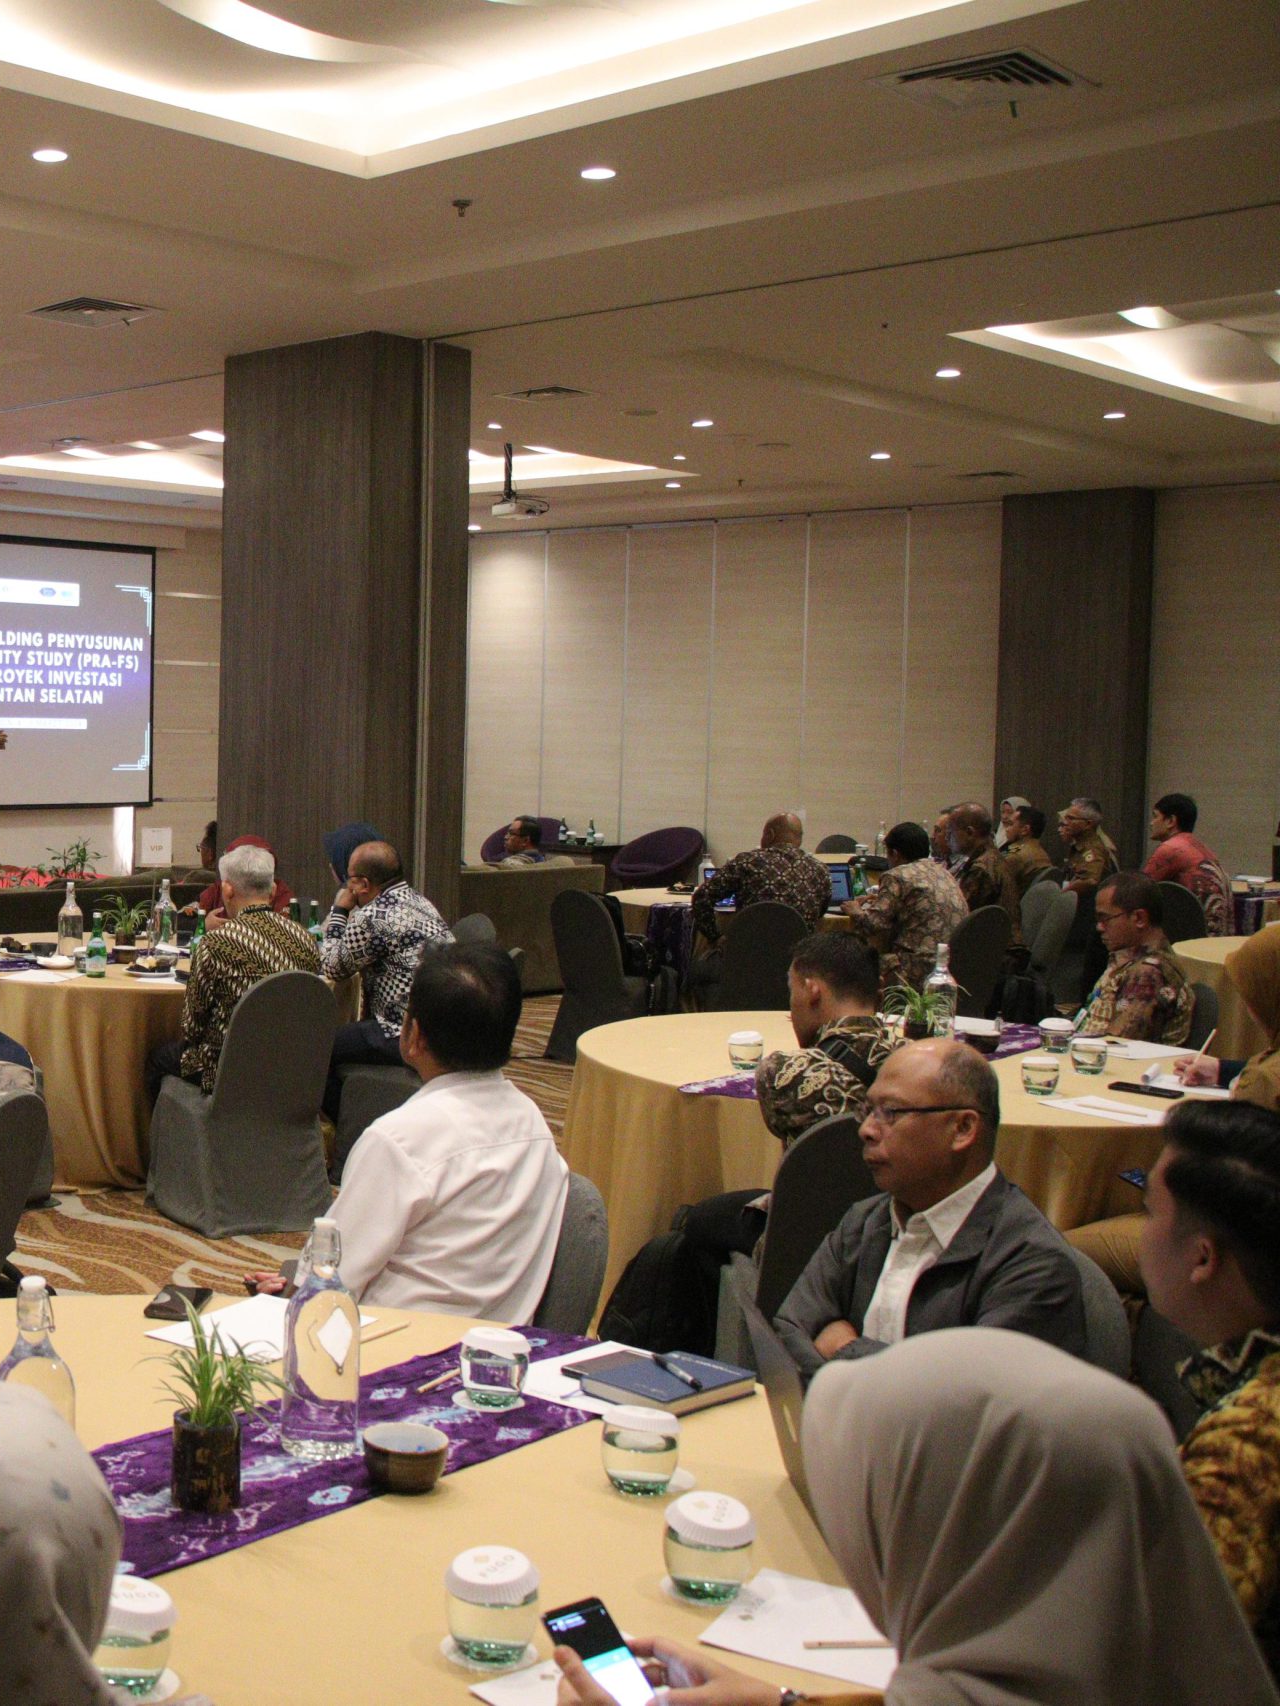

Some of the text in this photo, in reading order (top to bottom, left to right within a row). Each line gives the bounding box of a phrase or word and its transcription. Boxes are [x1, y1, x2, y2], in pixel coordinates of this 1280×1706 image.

[47, 633, 143, 651] PENYUSUNAN
[26, 650, 73, 667] STUDY
[78, 652, 139, 673] (PRA-FS)
[48, 670, 122, 687] INVESTASI
[40, 688, 103, 704] SELATAN
[150, 844, 164, 852] VIP
